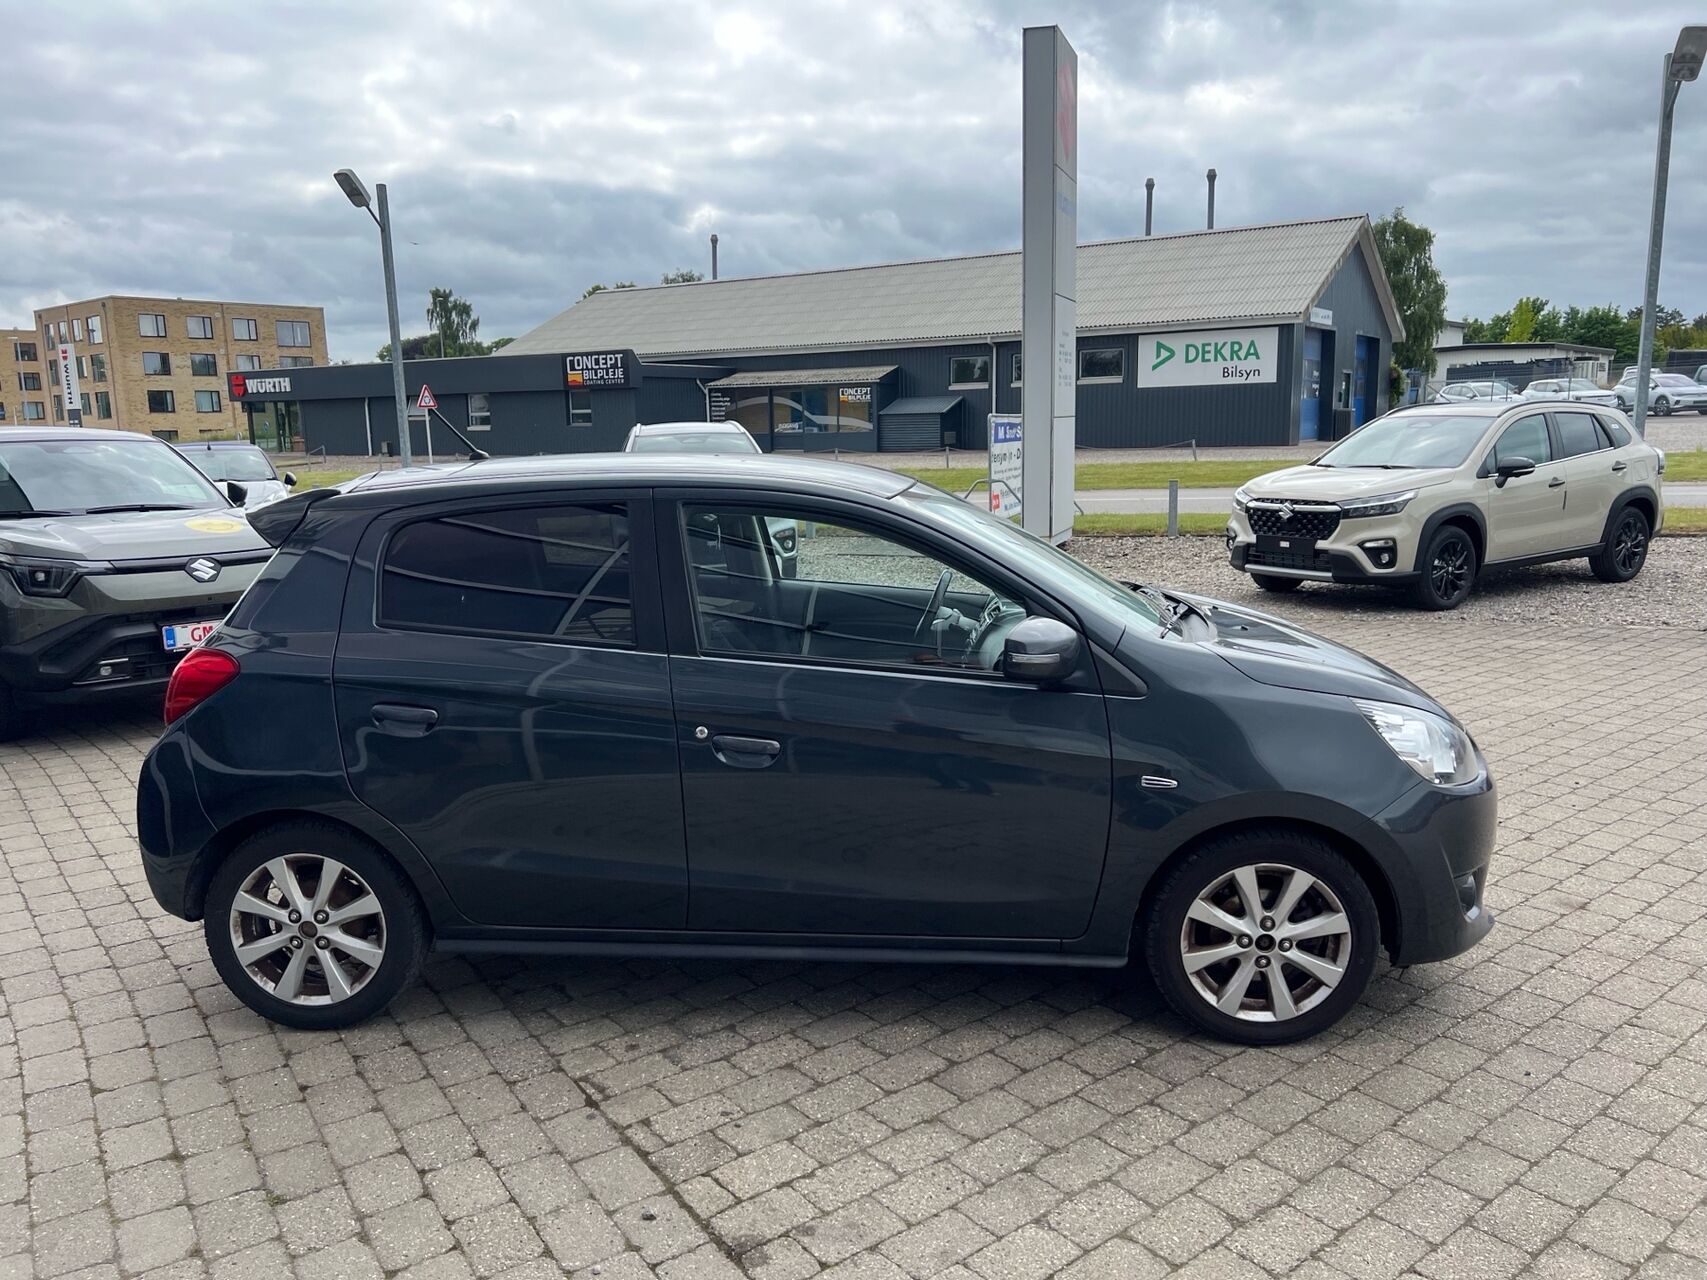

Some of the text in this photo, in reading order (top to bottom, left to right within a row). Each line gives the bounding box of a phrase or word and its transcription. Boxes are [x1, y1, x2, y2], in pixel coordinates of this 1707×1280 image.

[1184, 340, 1261, 364] DEKRA
[566, 354, 623, 373] CONCEPT
[583, 368, 624, 380] BILPLEJE
[1222, 365, 1261, 381] Bilsyn
[839, 387, 872, 398] CONCEPT
